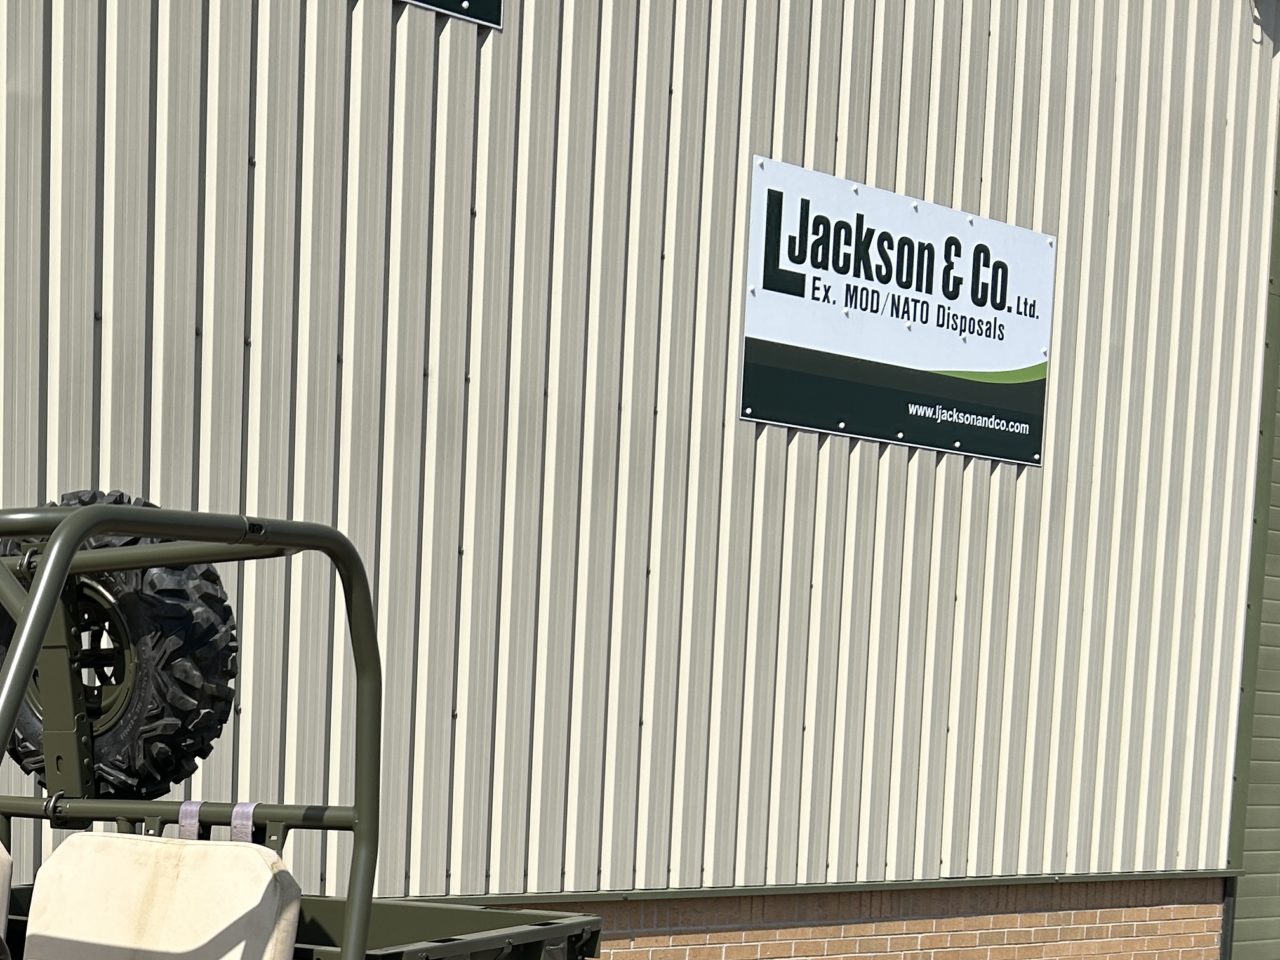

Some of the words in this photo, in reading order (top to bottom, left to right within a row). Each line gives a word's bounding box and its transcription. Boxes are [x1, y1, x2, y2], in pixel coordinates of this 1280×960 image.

[811, 275, 836, 305] Ex.
[844, 283, 930, 326] MOD/NATO
[936, 304, 1005, 341] Disposals
[941, 236, 964, 301] &
[970, 243, 1013, 314] Co.
[1016, 295, 1040, 320] Ltd.
[907, 402, 1029, 435] www.ljacksonandco.com
